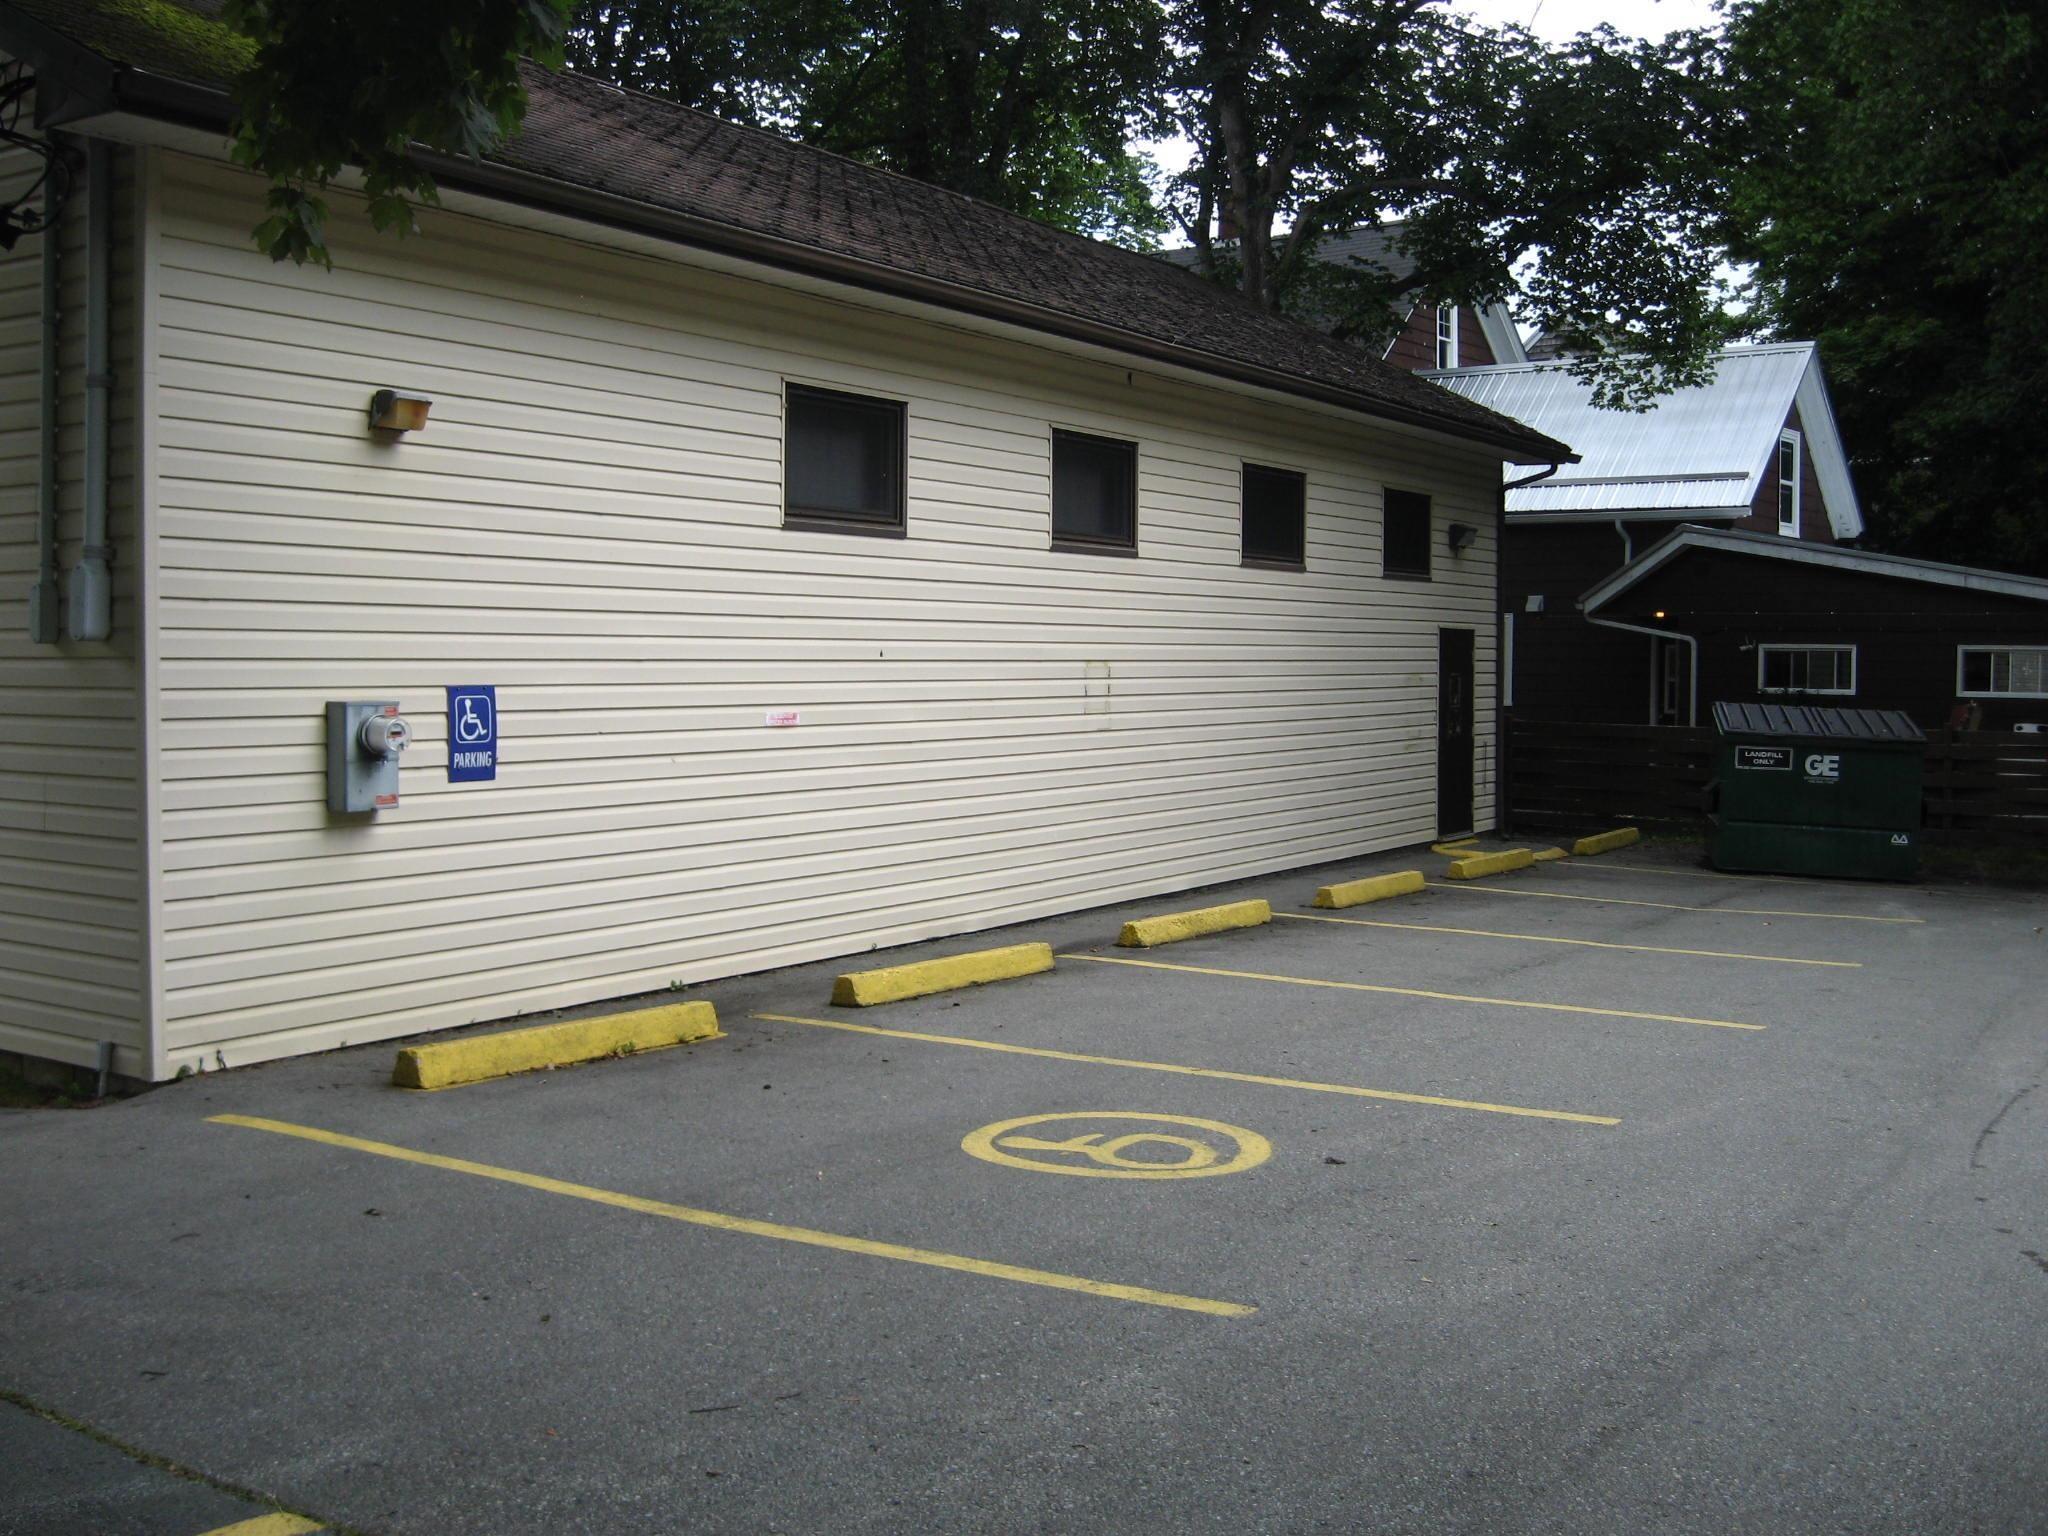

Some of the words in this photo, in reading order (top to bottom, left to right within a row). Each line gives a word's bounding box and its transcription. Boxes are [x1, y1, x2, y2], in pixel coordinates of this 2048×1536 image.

[453, 751, 492, 769] PARKING
[1745, 751, 1784, 759] LANDFILL
[1804, 754, 1840, 777] GE
